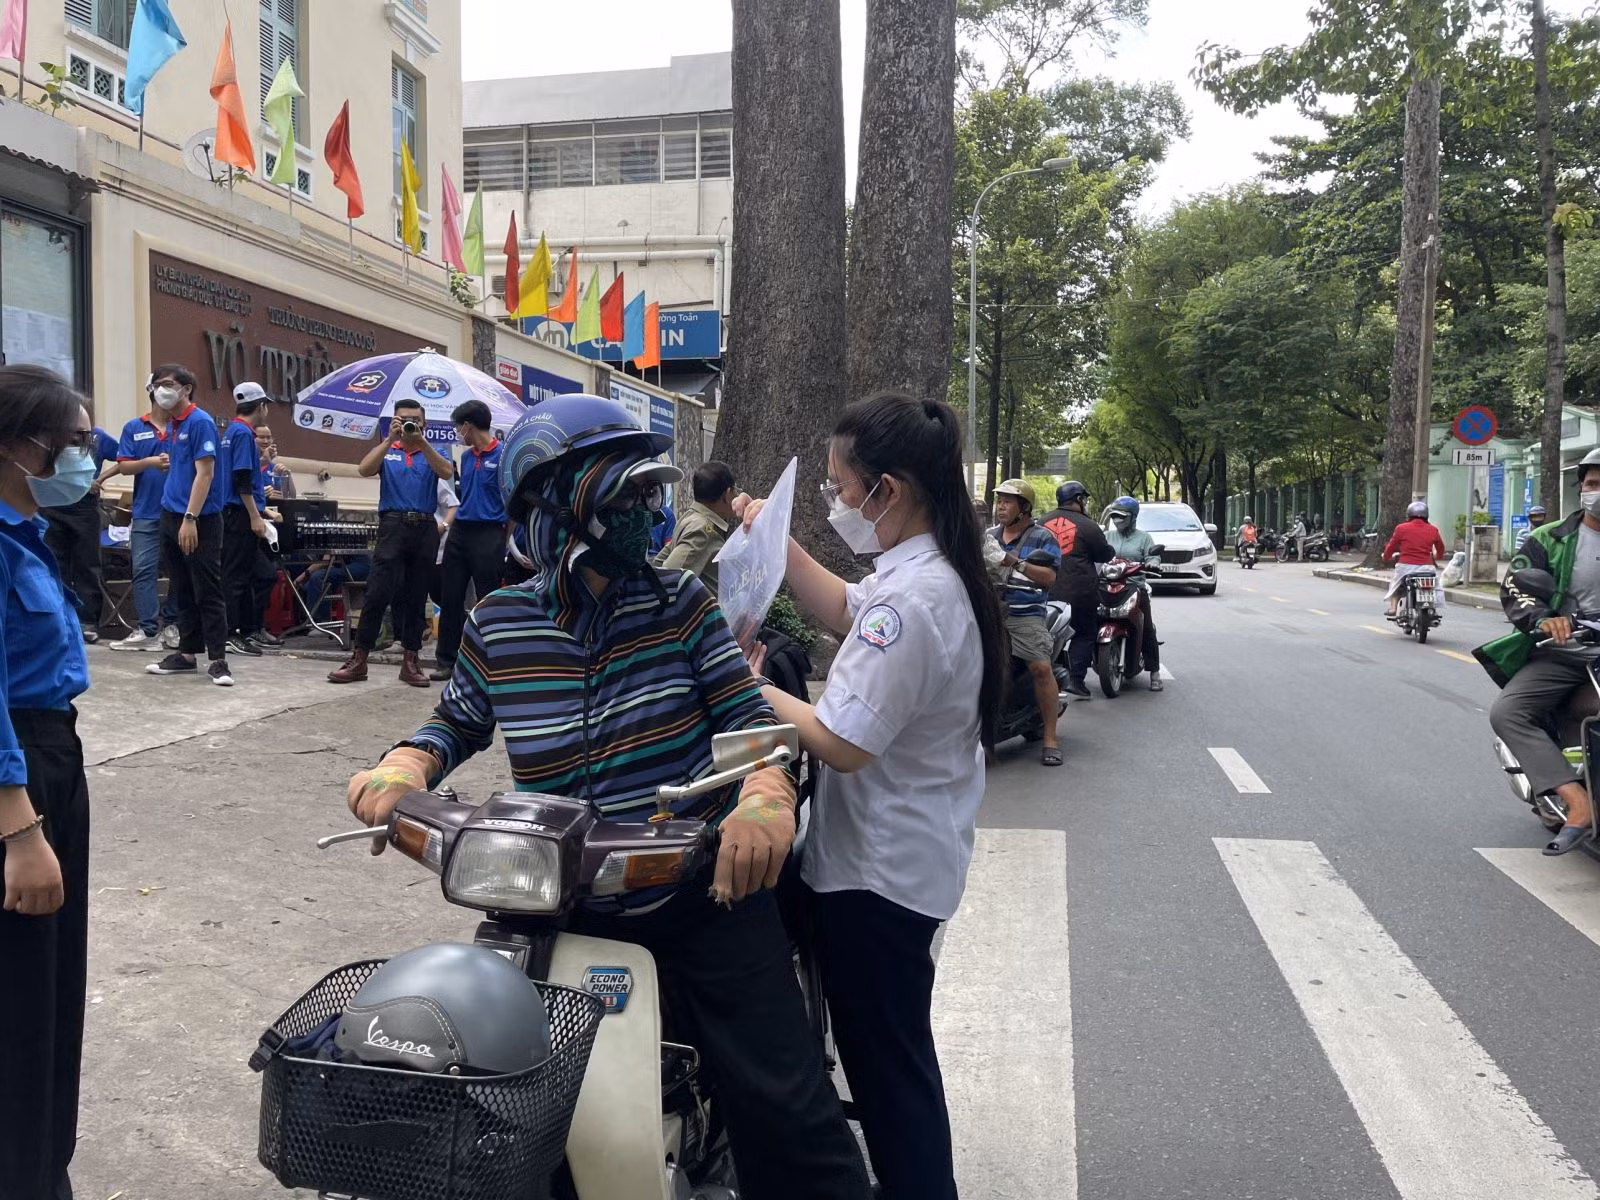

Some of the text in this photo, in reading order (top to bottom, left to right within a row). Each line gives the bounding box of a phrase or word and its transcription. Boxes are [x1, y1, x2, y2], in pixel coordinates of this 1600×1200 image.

[661, 328, 684, 346] IN
[203, 320, 250, 391] VÕ
[423, 429, 459, 441] 0156
[1466, 453, 1483, 462] 85m
[589, 974, 627, 984] ECONO
[591, 983, 629, 993] POWER
[363, 1015, 436, 1058] Vespa
